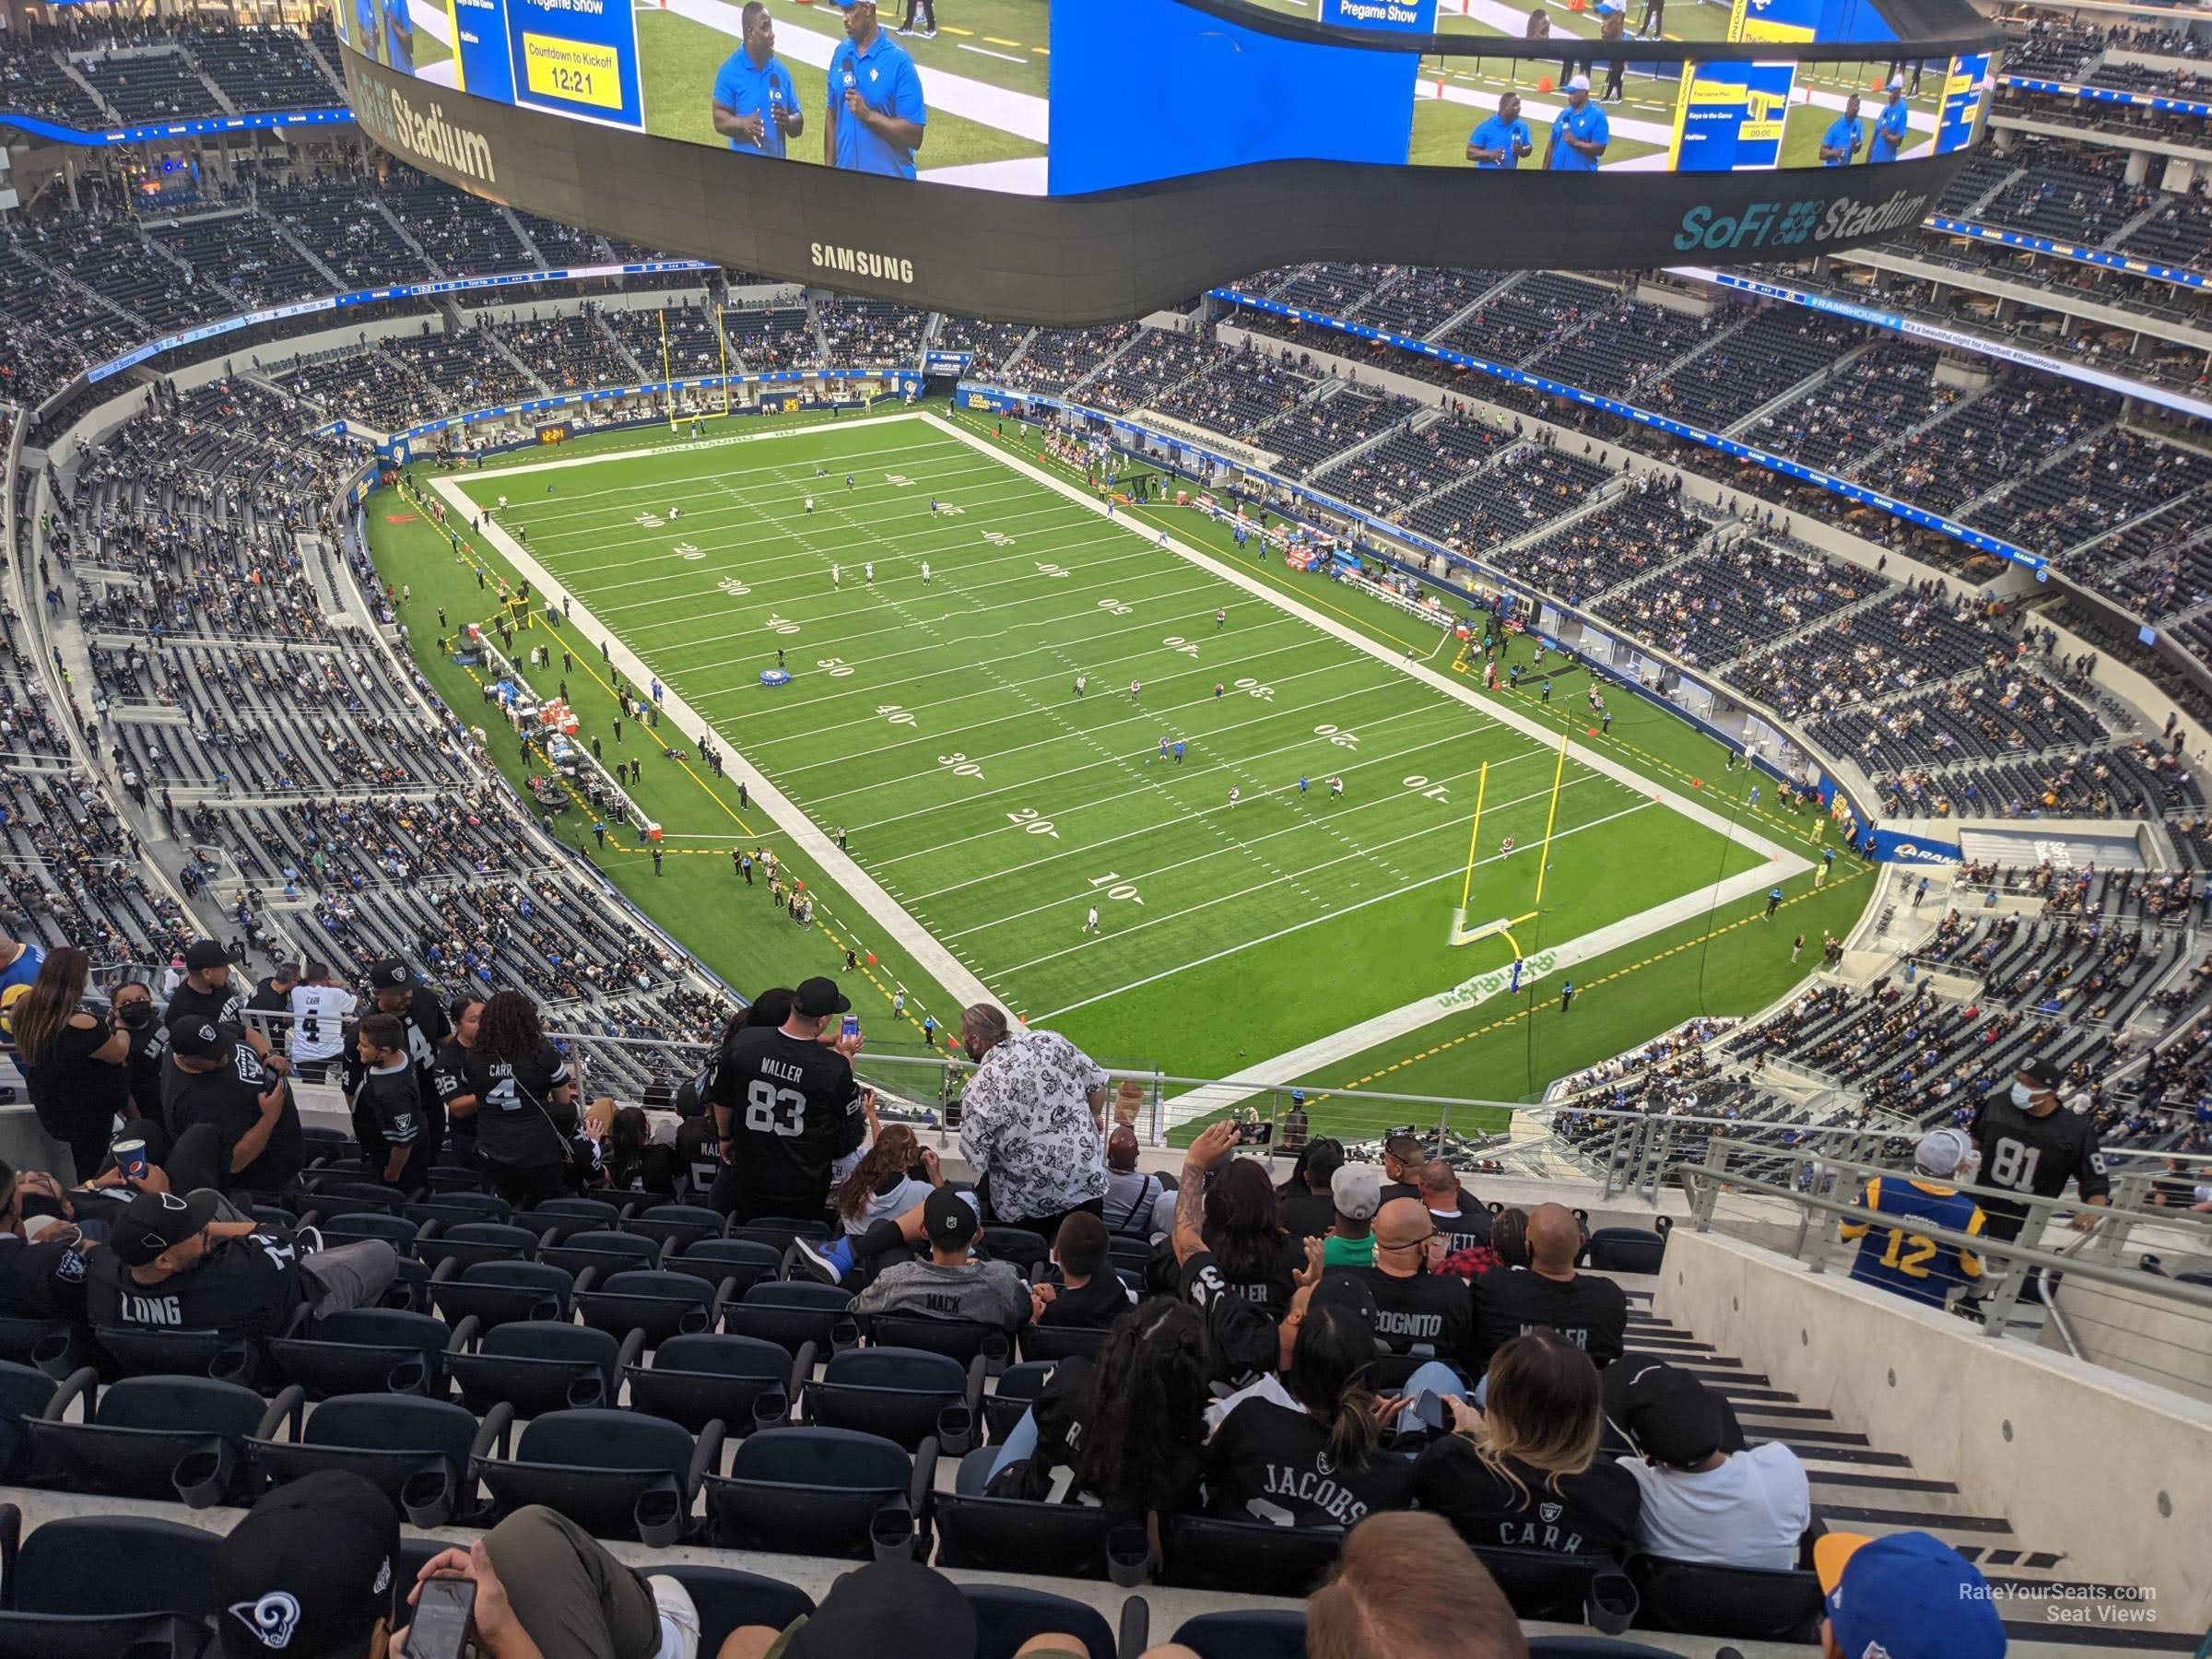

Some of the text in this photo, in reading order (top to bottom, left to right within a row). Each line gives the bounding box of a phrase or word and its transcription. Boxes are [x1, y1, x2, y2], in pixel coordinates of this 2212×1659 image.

[1340, 0, 1418, 23] Pregame Show
[528, 42, 612, 69] Countdown to Kickoff
[551, 66, 593, 95] 12:21
[391, 88, 496, 182] Stadium
[1673, 190, 1927, 251] SoFi Stadium
[811, 242, 913, 284] SAMSUNG
[1811, 297, 1888, 324] #RAMSHOUSE
[1904, 323, 1915, 331] It's
[1922, 326, 1952, 341] beautiful
[1952, 335, 1971, 346] night
[1971, 340, 1983, 348] for
[2012, 351, 2061, 371] #RamsHouse
[306, 996, 321, 1005] CARR
[302, 1009, 320, 1041] 4
[407, 1023, 435, 1069] 4
[489, 1064, 513, 1077] CARR
[760, 1057, 804, 1083] WALLER
[486, 1078, 522, 1111] 4
[746, 1079, 806, 1137] 83
[1991, 1136, 2041, 1194] 81
[1880, 1229, 1936, 1278] 12
[120, 1290, 182, 1325] LONG
[926, 1293, 961, 1313] MACK
[1263, 1464, 1369, 1526] JACOBS
[1500, 1522, 1583, 1553] CARR
